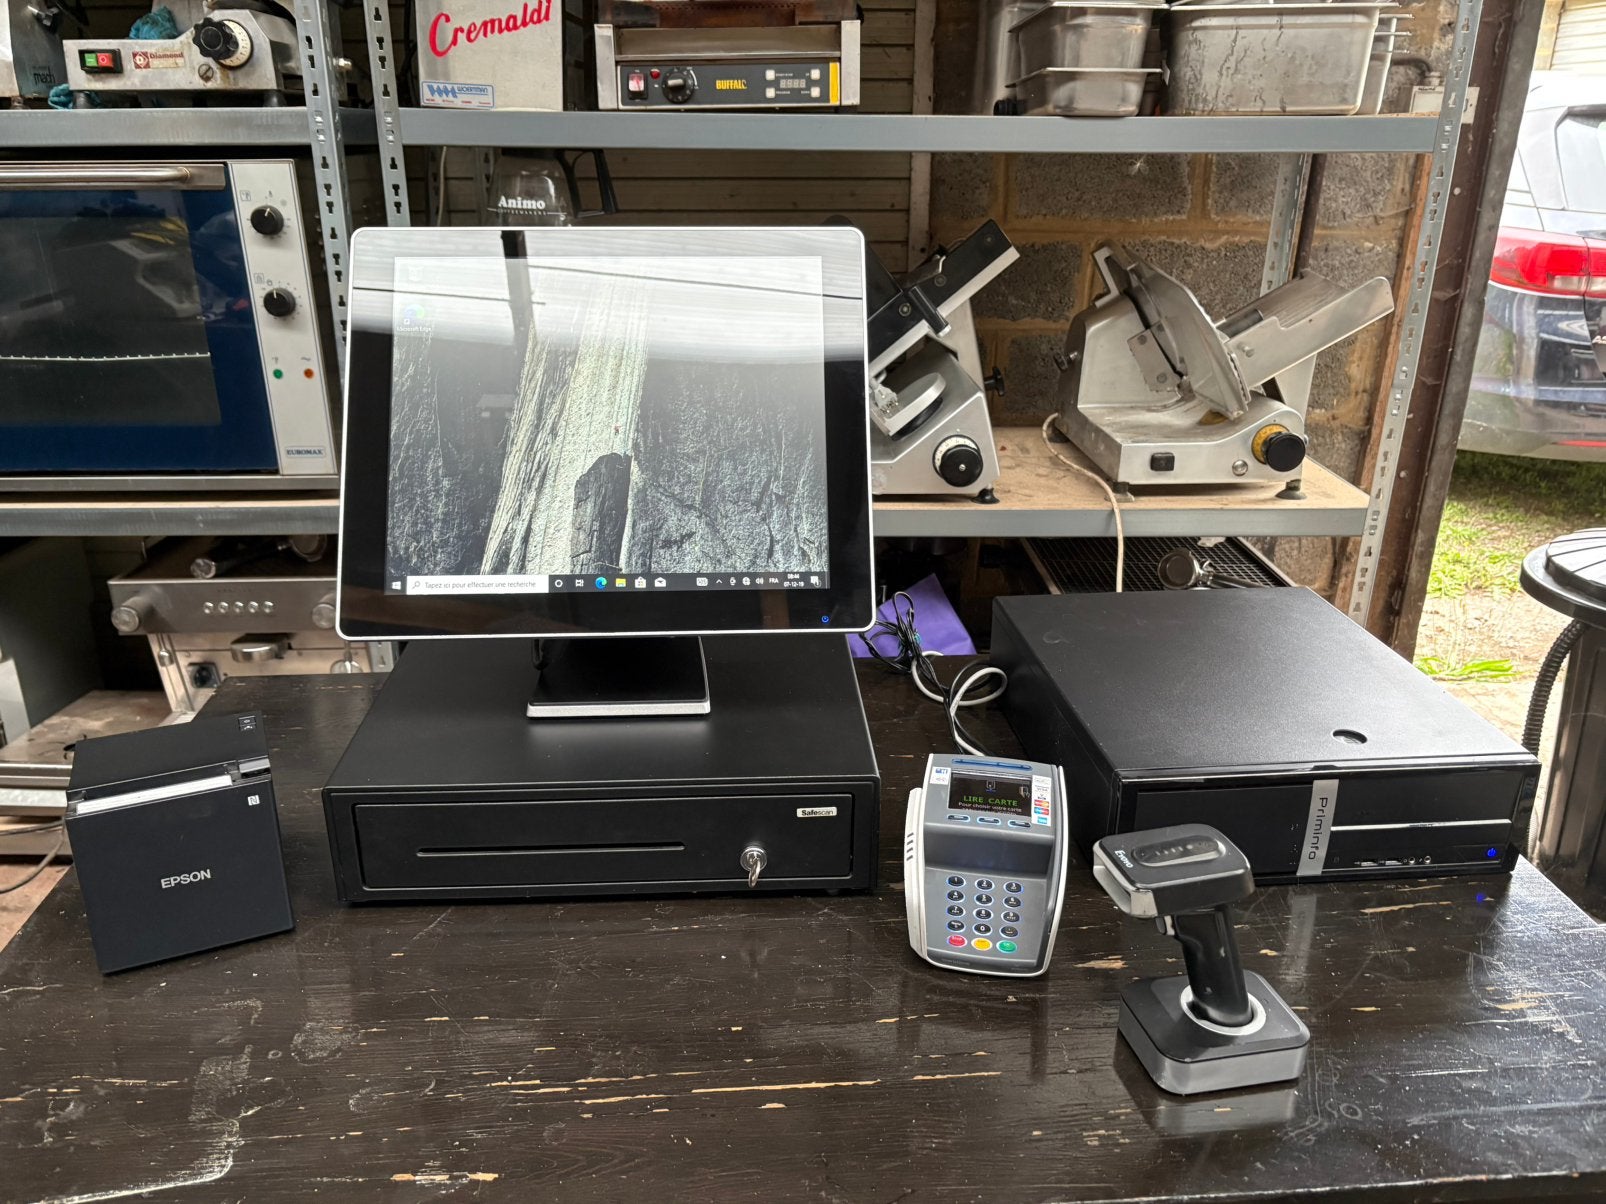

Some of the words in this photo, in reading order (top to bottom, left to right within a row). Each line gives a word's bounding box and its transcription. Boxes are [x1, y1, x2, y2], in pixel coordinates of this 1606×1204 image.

[428, 0, 552, 58] Cremaldi
[150, 51, 184, 59] Diamond
[498, 195, 546, 210] Animo
[425, 581, 442, 589] Tapez
[963, 795, 984, 803] LIRE
[988, 797, 1018, 807] CARTE
[801, 809, 834, 817] Safescan
[1308, 797, 1329, 860] Priminfo
[160, 868, 211, 889] EPSON
